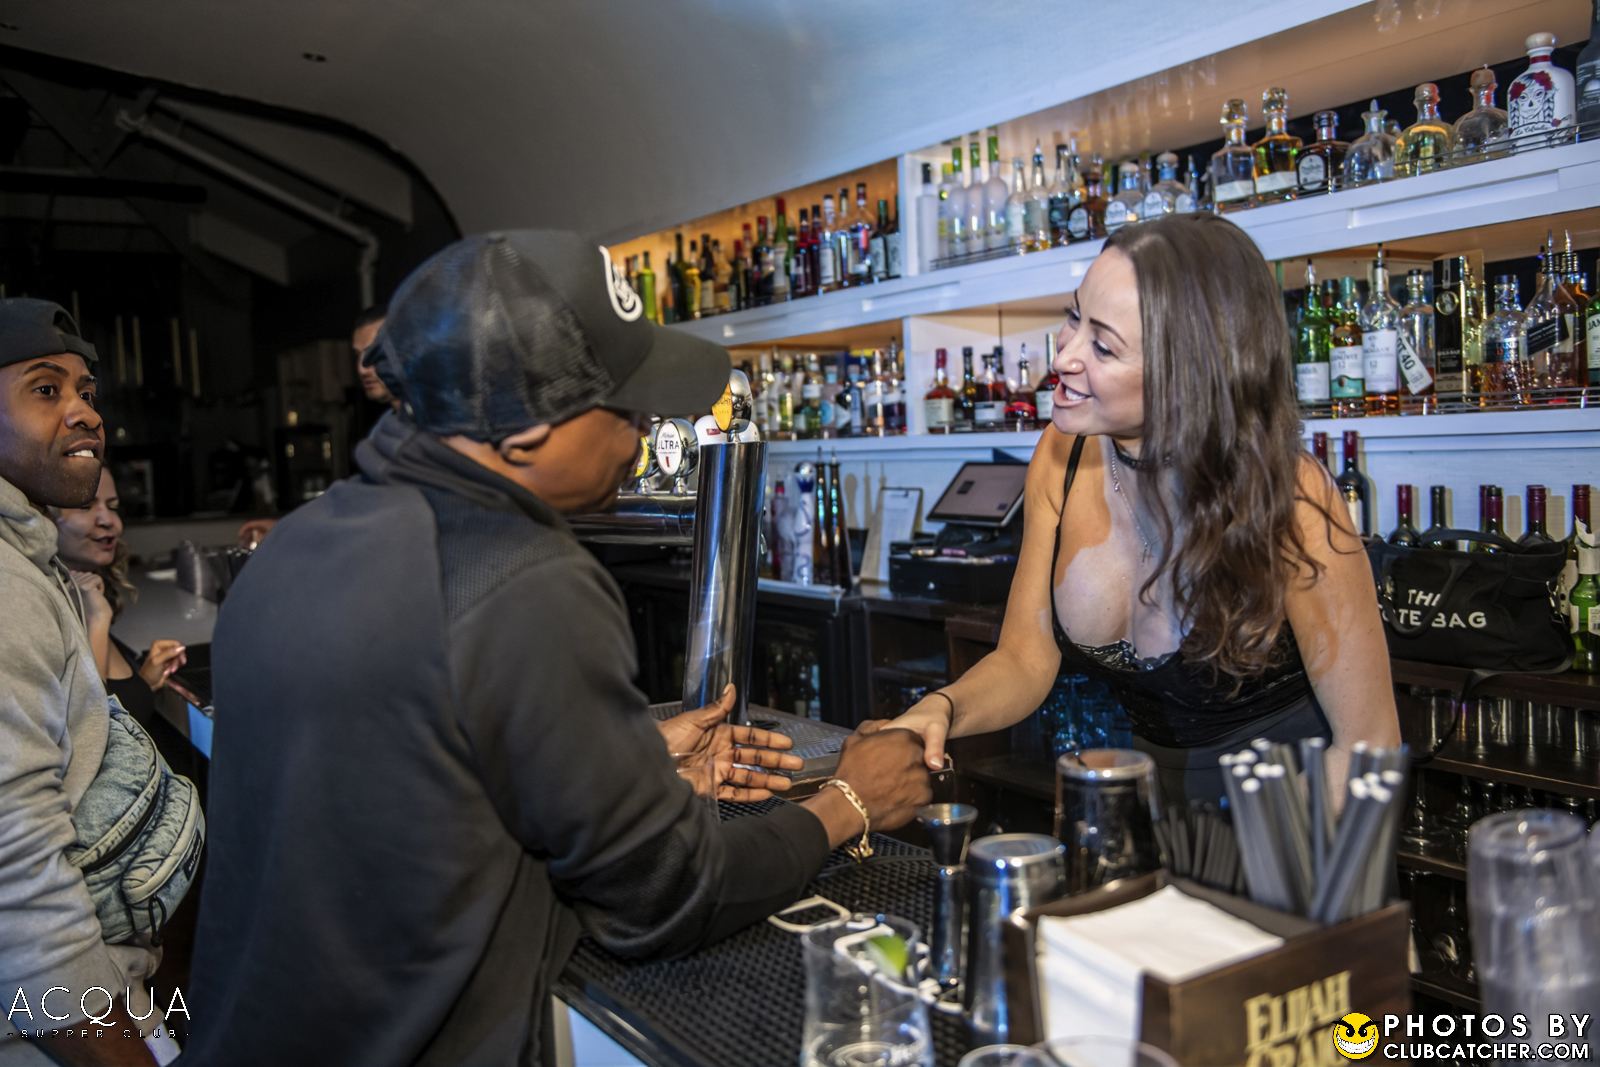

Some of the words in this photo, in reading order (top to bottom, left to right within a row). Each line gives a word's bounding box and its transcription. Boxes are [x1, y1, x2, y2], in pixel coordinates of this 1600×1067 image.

[1402, 354, 1416, 370] 40
[1379, 604, 1421, 627] TE
[1431, 611, 1487, 628] BAG
[1244, 970, 1351, 1050] ELIJAH
